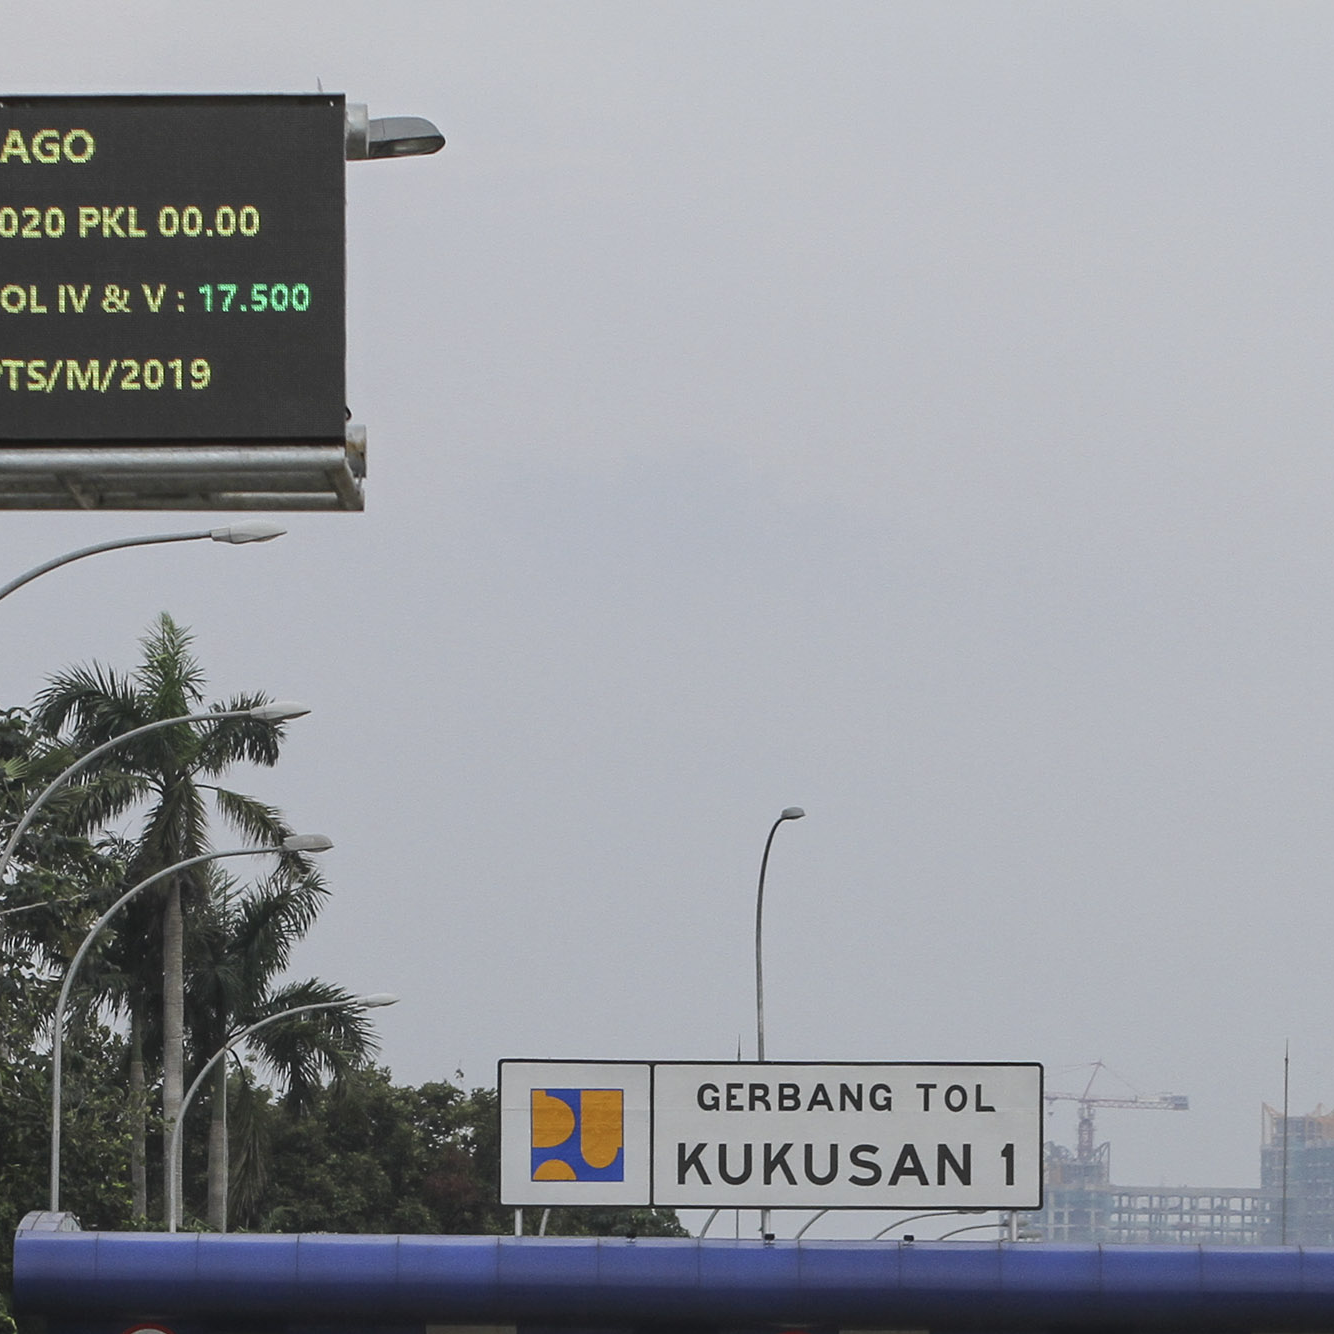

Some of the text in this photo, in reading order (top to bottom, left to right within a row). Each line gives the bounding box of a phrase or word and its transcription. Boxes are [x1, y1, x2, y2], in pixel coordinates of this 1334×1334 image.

[78, 206, 147, 238] PKL
[158, 205, 260, 238] 00.00
[58, 284, 91, 314] IV
[101, 284, 131, 313] &
[141, 284, 166, 313] V
[198, 283, 310, 313] 17.500
[697, 1083, 997, 1113] GERBANG TOL
[677, 1143, 1016, 1187] KUKUSAN 1
